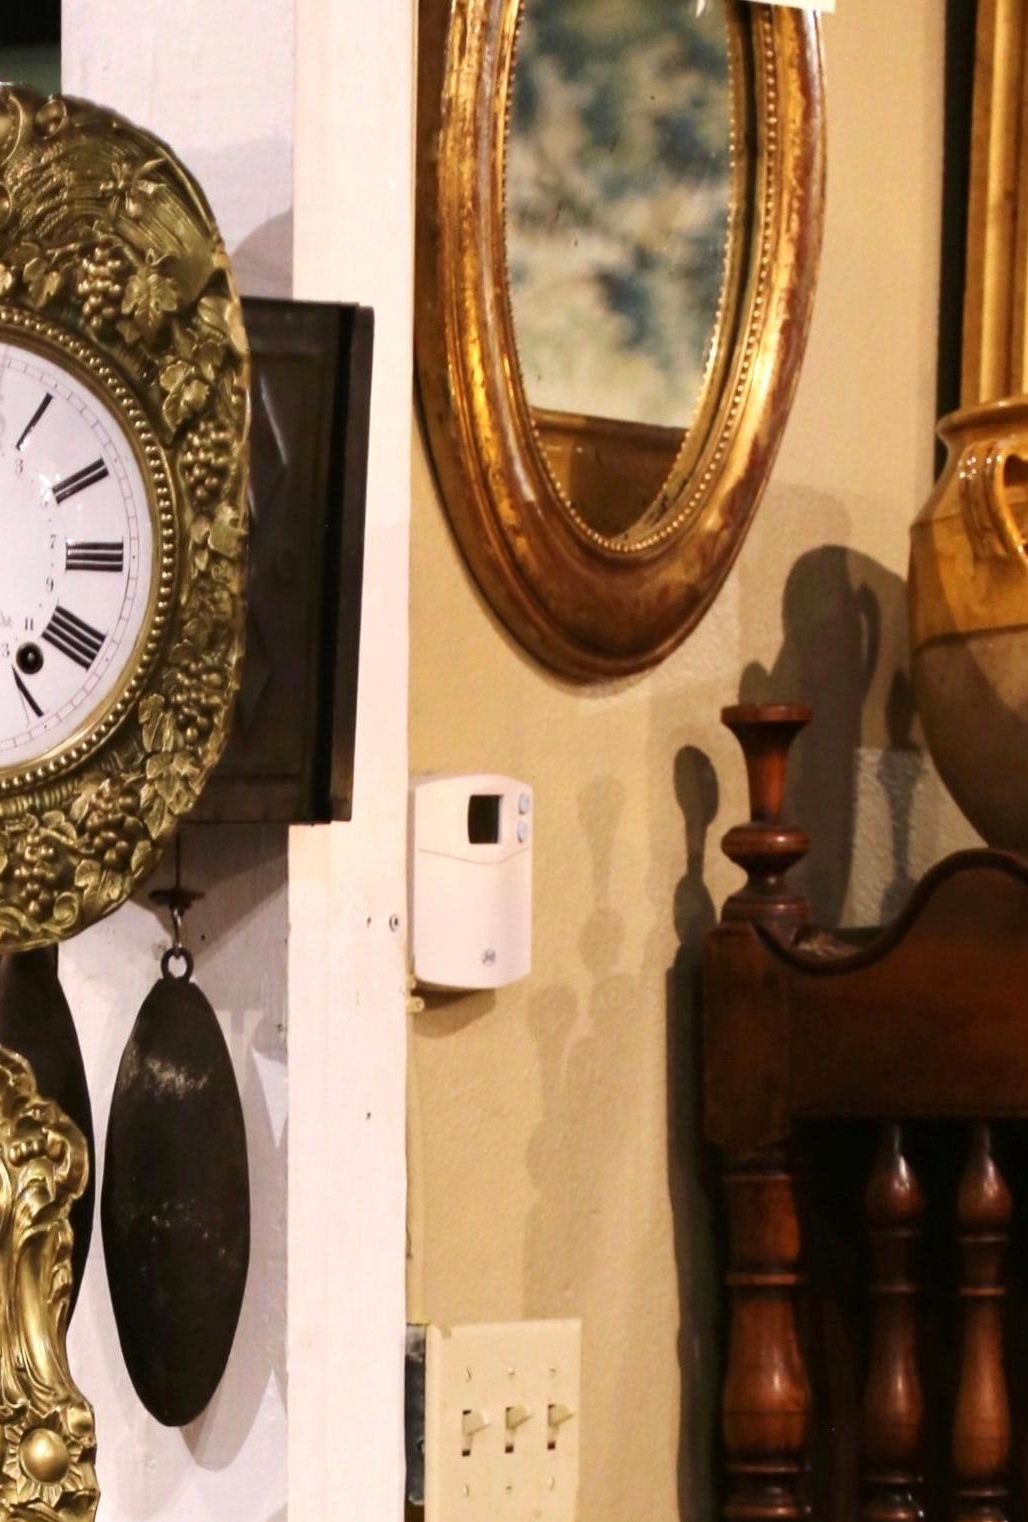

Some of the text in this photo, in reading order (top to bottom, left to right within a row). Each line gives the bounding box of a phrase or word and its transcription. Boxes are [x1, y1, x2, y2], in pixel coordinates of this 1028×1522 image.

[52, 457, 109, 505] II
[65, 540, 124, 573] III
[46, 576, 54, 592] 9
[41, 604, 107, 671] IIII
